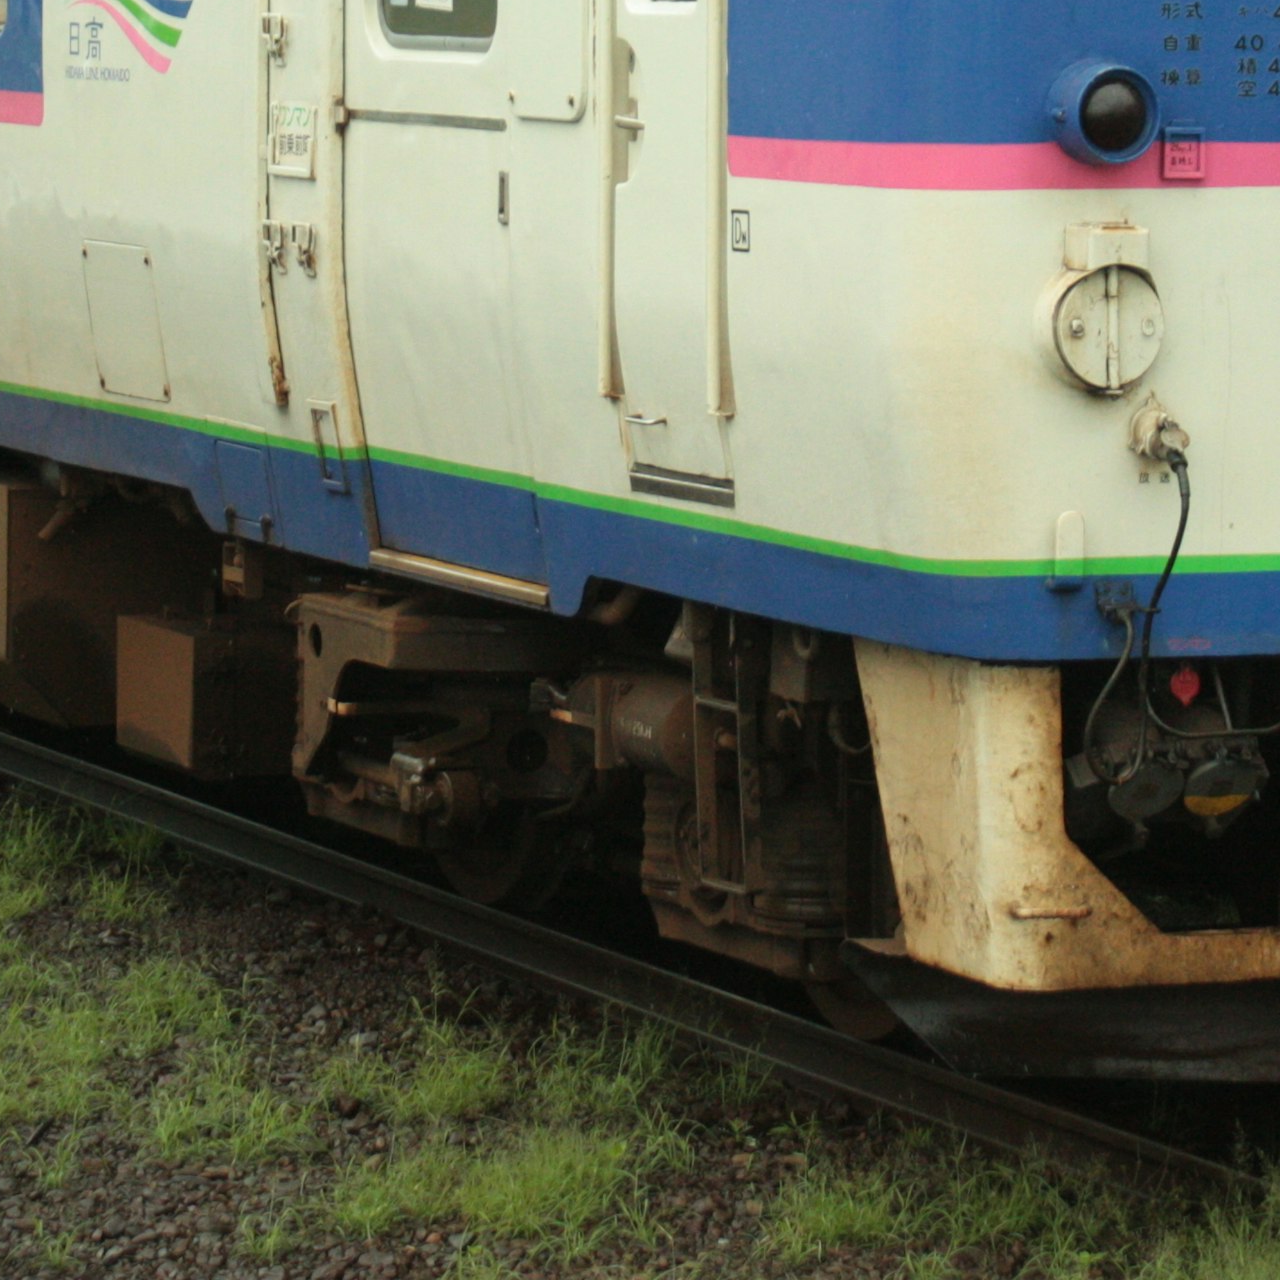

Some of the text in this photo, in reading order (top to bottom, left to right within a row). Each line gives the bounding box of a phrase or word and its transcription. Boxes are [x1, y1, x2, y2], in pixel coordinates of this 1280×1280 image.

[1160, 1, 1203, 19] 形式
[69, 15, 104, 61] 日高
[1163, 34, 1202, 51] 自重
[1160, 70, 1202, 86] 換算
